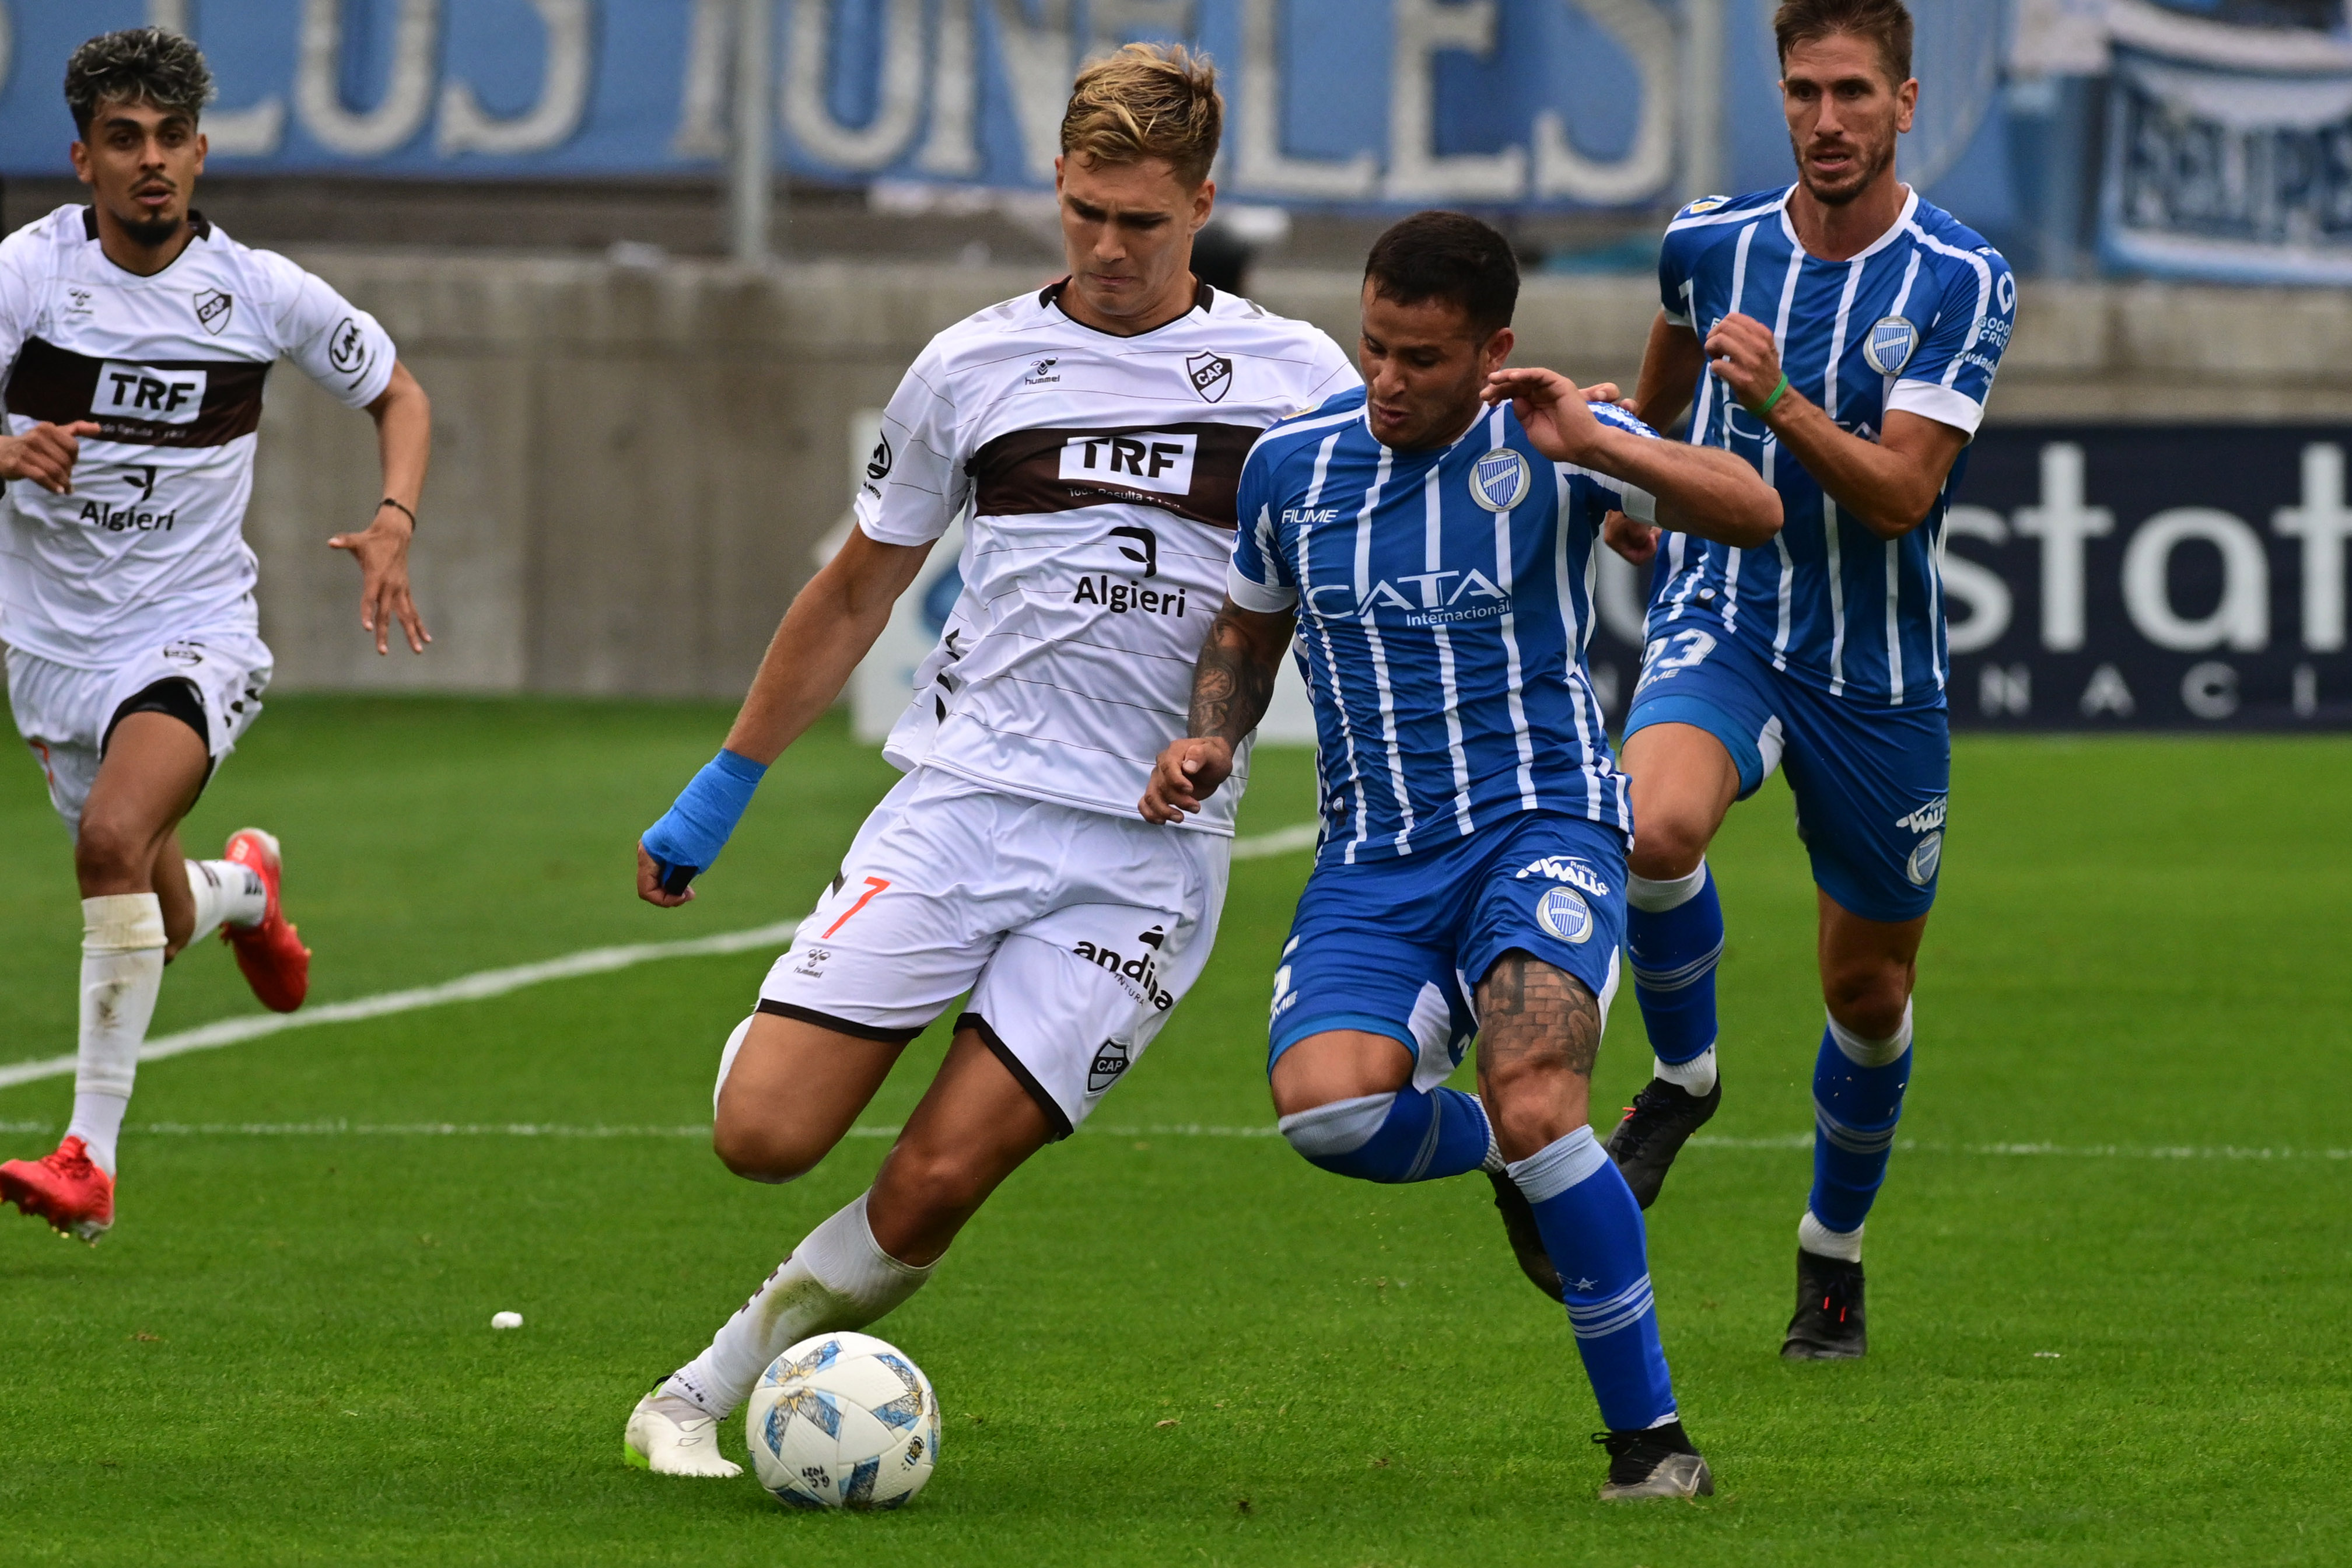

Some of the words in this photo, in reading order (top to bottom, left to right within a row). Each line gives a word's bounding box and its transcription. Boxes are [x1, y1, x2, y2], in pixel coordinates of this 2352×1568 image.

[1025, 375, 1060, 385] hummel
[1196, 362, 1223, 386] CAP
[110, 372, 195, 411] TRF
[1084, 438, 1184, 478] TRF
[80, 501, 177, 531] Algieri
[1282, 509, 1339, 524] FIUME
[1073, 575, 1186, 617] Algieri
[1306, 568, 1507, 619] CATA
[1406, 600, 1510, 627] Internacional
[1540, 858, 1601, 897] WALL
[1570, 860, 1597, 878] Pinturas
[821, 876, 891, 939] 7
[793, 965, 823, 978] hummel
[1073, 940, 1174, 1012] andina
[1097, 1059, 1123, 1072] CAP
